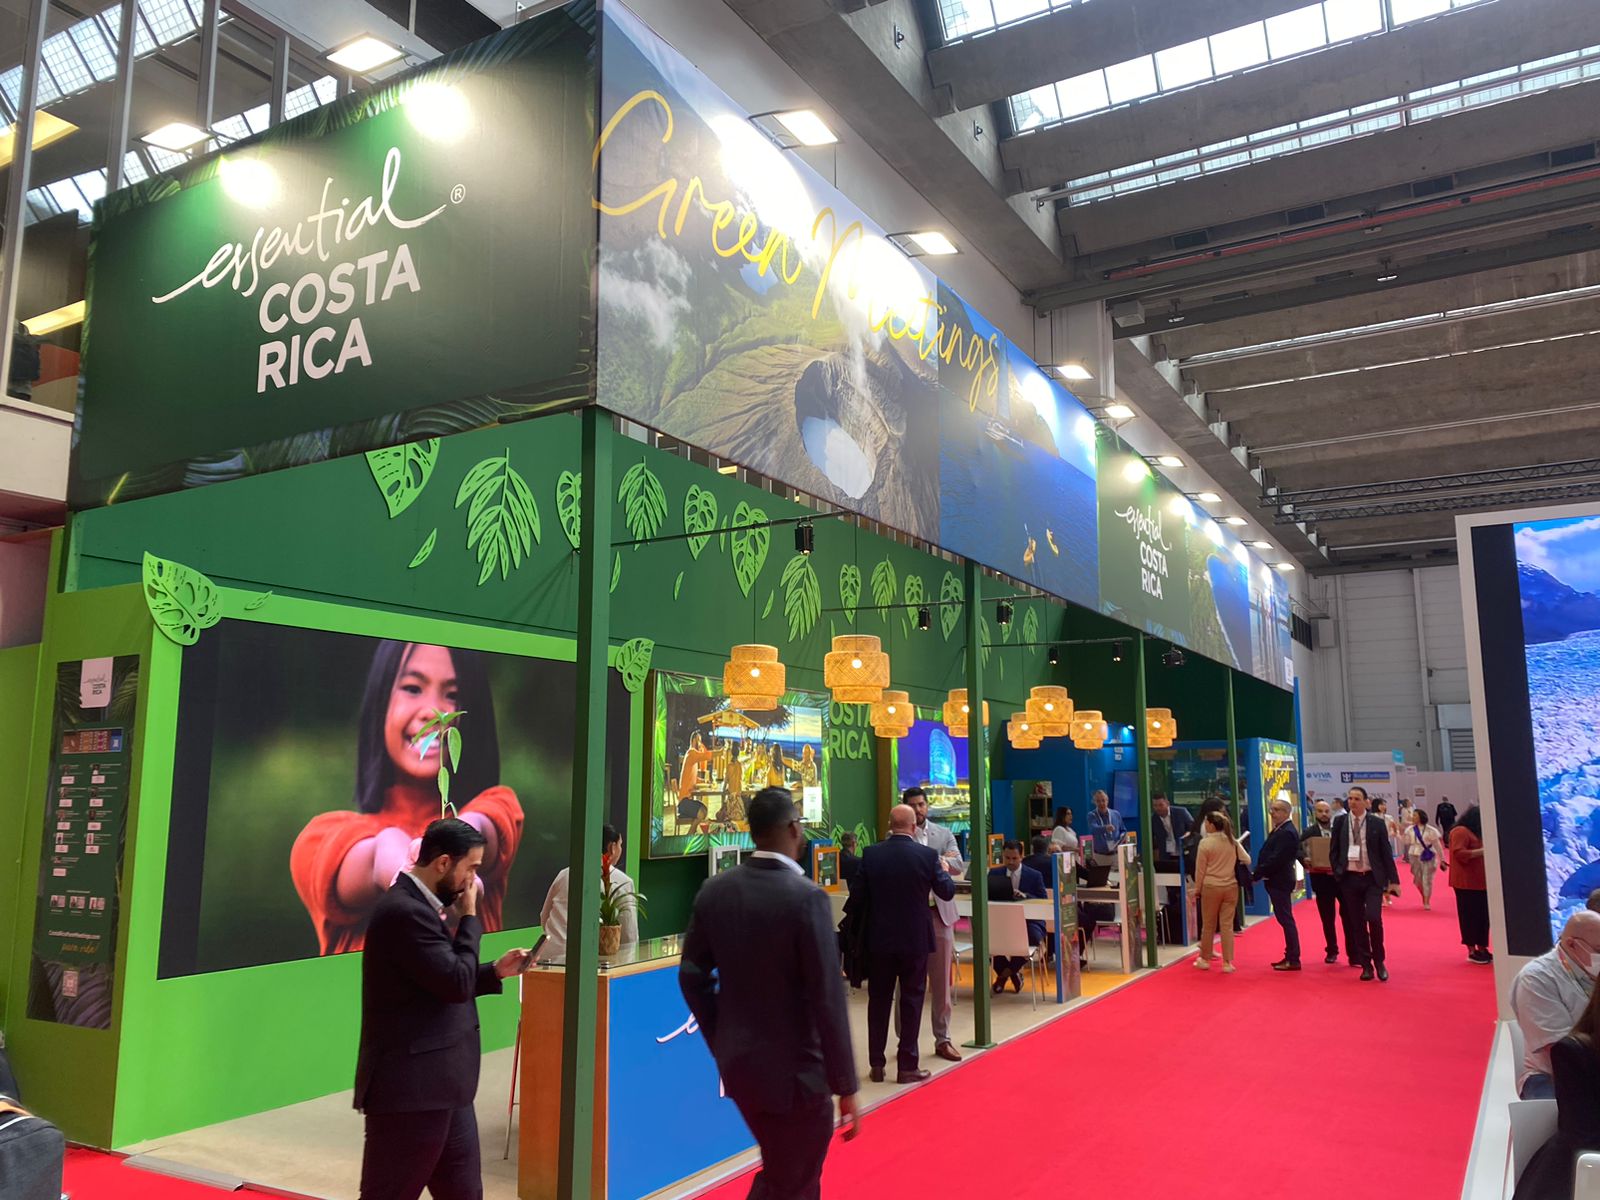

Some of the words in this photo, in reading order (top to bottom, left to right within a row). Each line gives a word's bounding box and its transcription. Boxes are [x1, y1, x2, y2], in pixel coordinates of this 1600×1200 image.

[591, 90, 802, 284] Green
[152, 147, 446, 303] essential
[259, 243, 421, 333] COSTA
[257, 317, 373, 393] RICA
[1114, 504, 1171, 551] essential
[1140, 541, 1169, 579] COSTA
[1141, 567, 1163, 600] RICA
[829, 729, 872, 760] RICA
